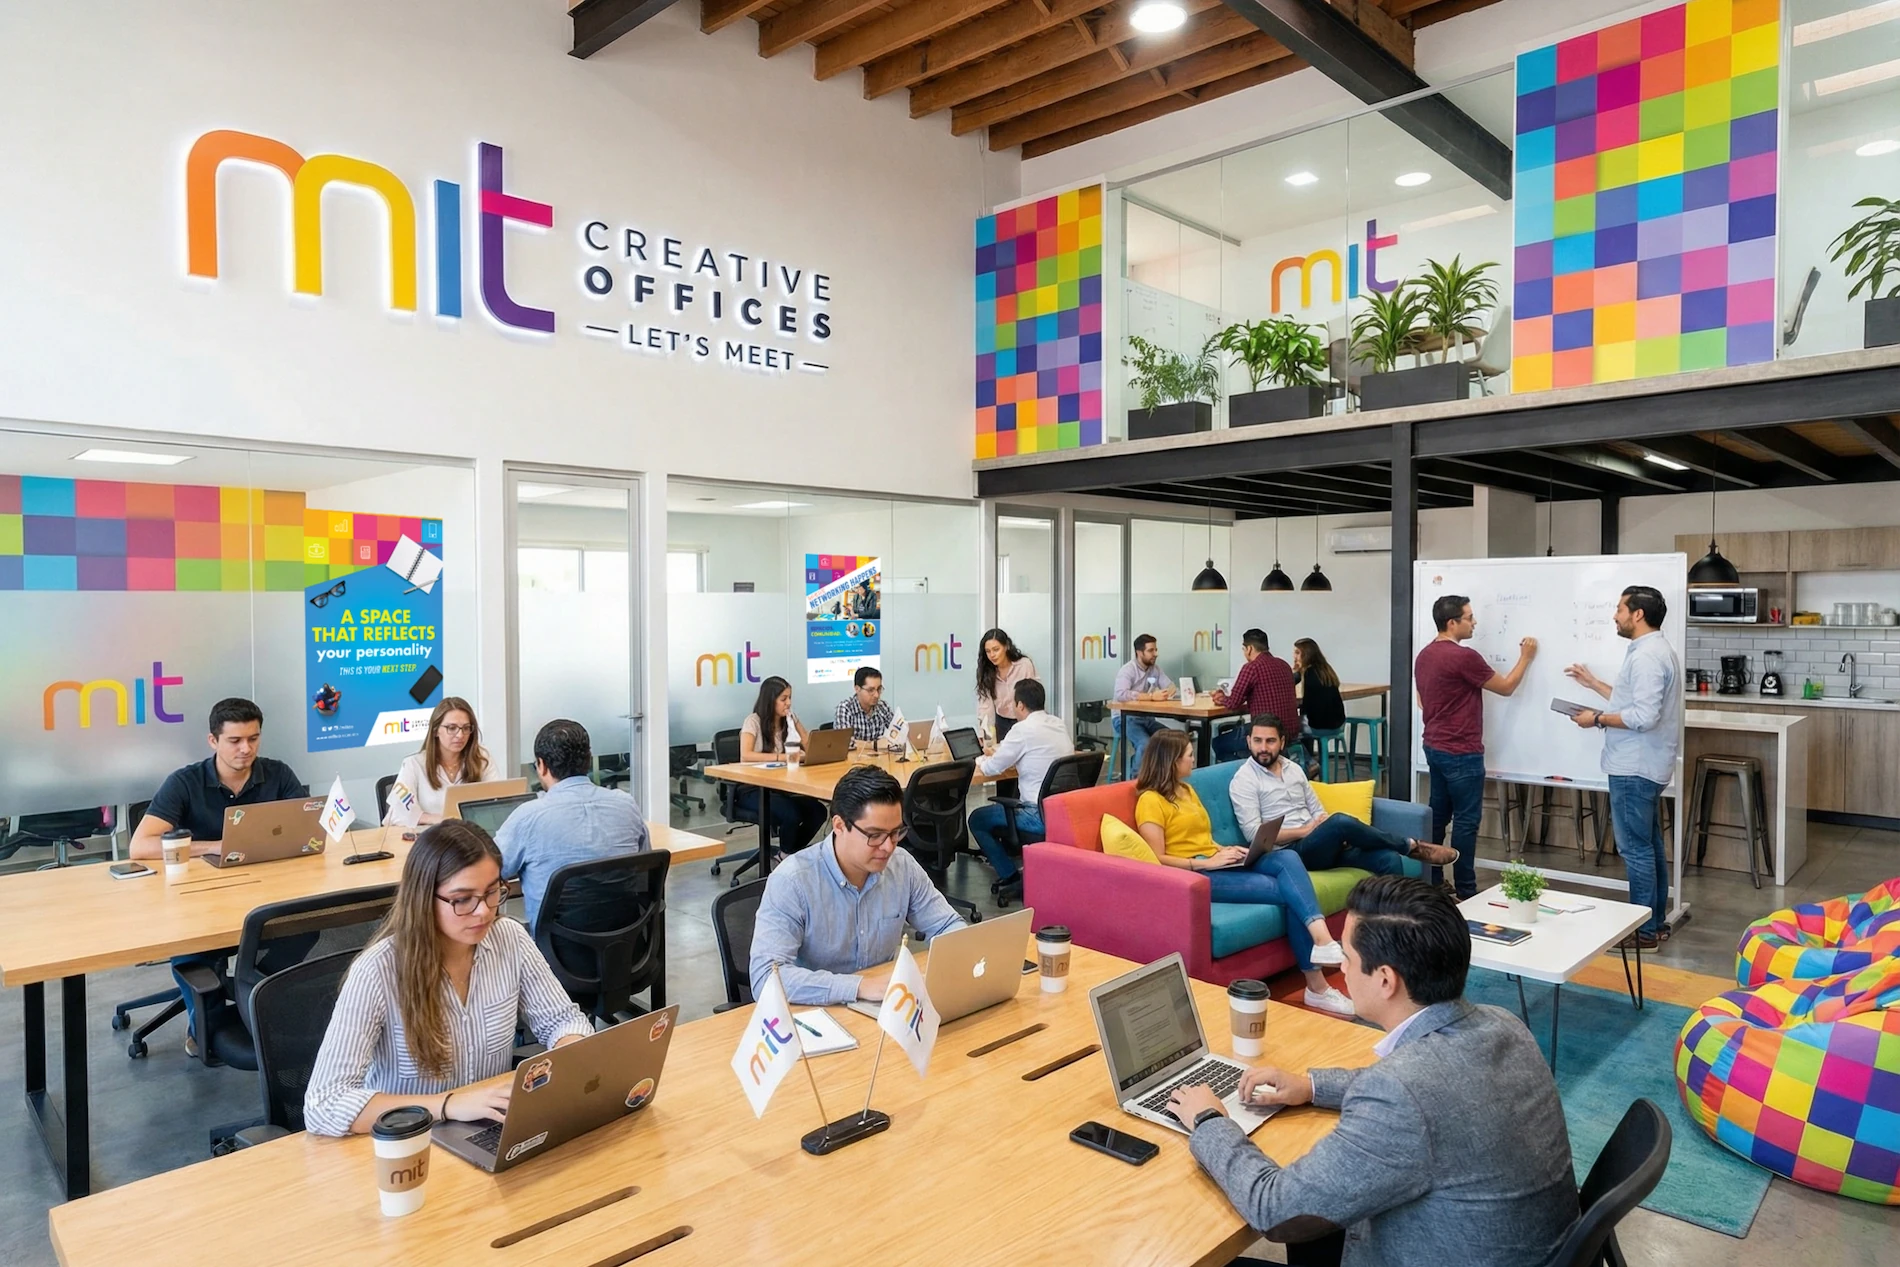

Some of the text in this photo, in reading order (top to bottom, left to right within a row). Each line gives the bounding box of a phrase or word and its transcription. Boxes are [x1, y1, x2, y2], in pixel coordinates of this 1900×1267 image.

[187, 129, 555, 333] mit
[585, 221, 831, 302] CREATIVE
[1271, 219, 1398, 314] mit
[584, 265, 831, 339] OFFICES
[629, 324, 795, 371] LET'S MEET
[809, 581, 850, 609] NETWORKING
[850, 566, 877, 587] HAPPENS
[312, 626, 436, 642] THAT REFLECTS
[340, 609, 411, 625] A SPACE
[316, 642, 433, 663] your personality
[914, 633, 962, 673] mit
[1081, 627, 1117, 660] mit
[1194, 623, 1222, 653] mit
[339, 666, 355, 676] THIS
[355, 666, 362, 675] IS
[363, 666, 381, 675] YOUR
[381, 664, 399, 674] NEXT
[695, 640, 761, 687] mit
[43, 661, 184, 731] mit
[384, 717, 410, 734] mit
[328, 798, 350, 832] mit
[393, 782, 415, 811] mit
[887, 982, 924, 1042] mit
[750, 1017, 793, 1086] mit
[390, 1159, 425, 1185] mit
